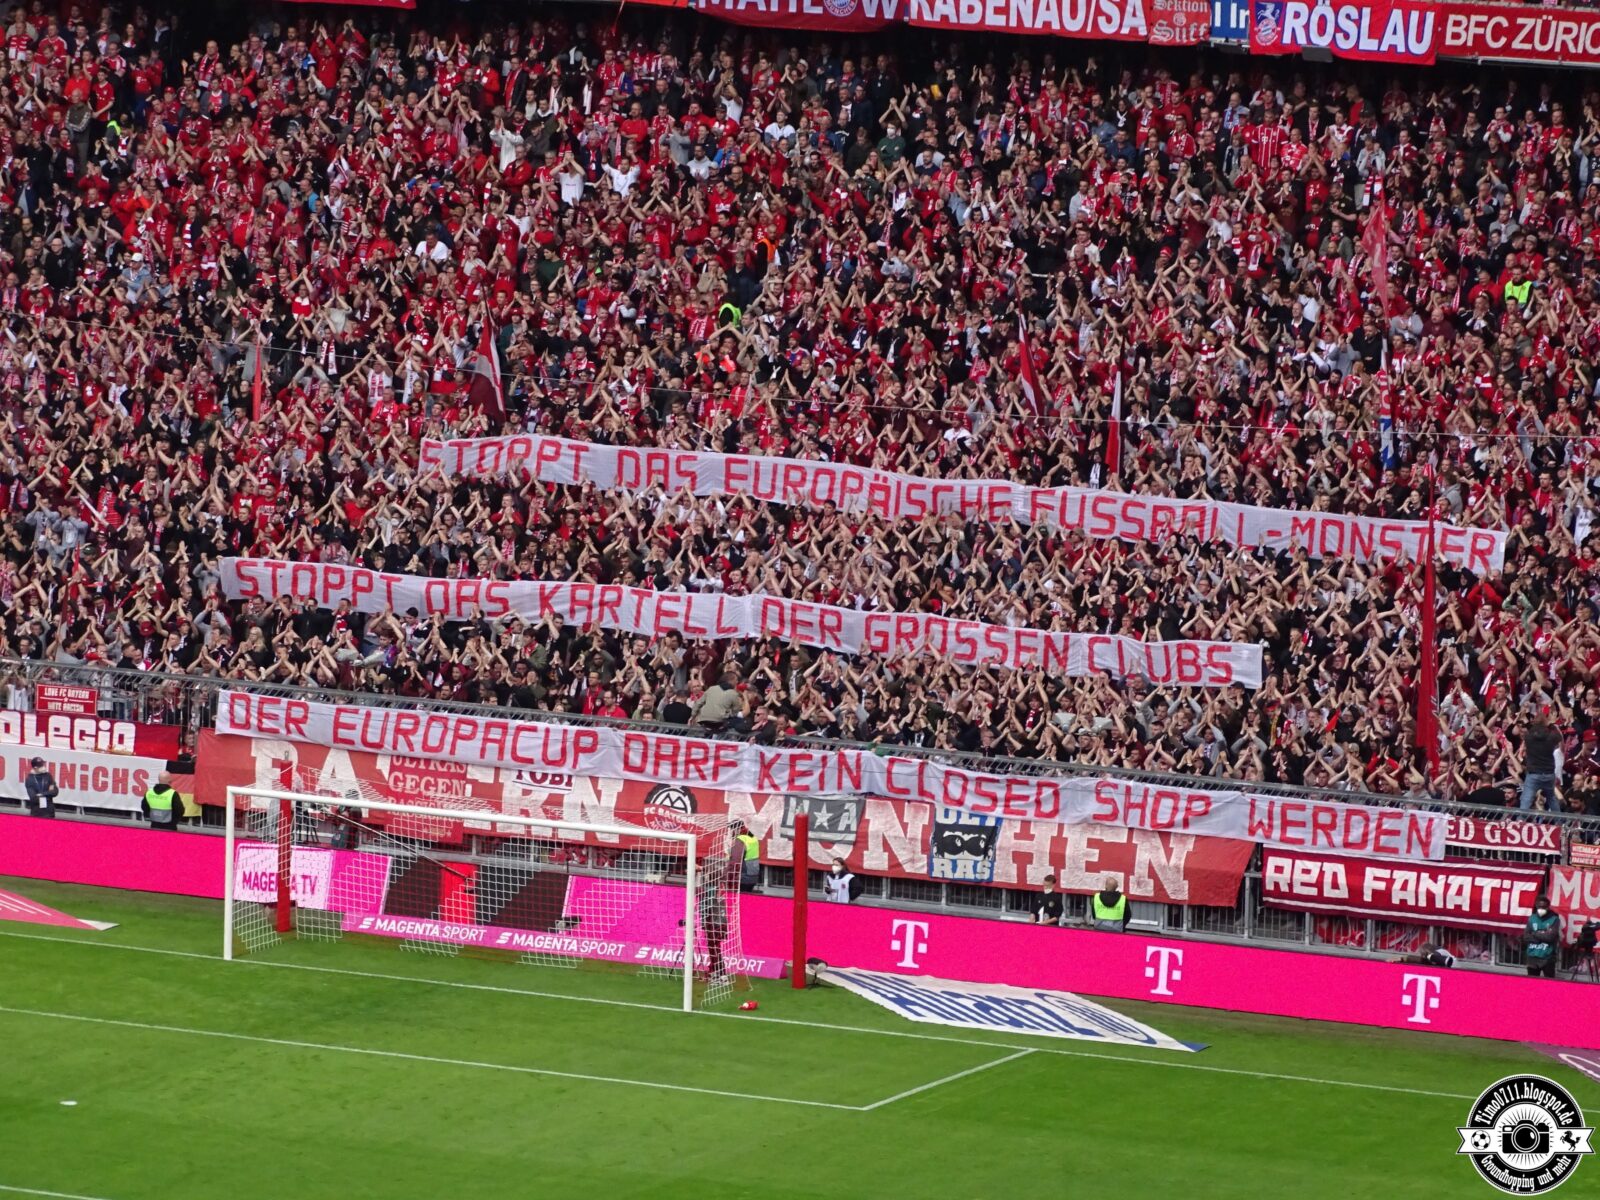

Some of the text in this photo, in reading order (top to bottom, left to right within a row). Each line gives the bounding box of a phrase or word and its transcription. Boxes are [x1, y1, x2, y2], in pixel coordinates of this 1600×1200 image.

[1282, 0, 1436, 56] RÖSLAU
[1445, 14, 1508, 49] BFC
[421, 436, 590, 482] STOPPT
[616, 449, 699, 493] DAS
[723, 456, 1013, 525] EUROPÄISCHE
[235, 560, 1233, 685] STOPPT DAS KARTELL DER GROSSEN CLUBS
[228, 692, 1436, 861] DER EUROPACUP DARF KEIN CLOSED SHOP WERDEN
[388, 772, 467, 798] GEGEN
[932, 858, 993, 881] RAS
[242, 871, 318, 896] MAGEA TV
[374, 916, 488, 943] MAGENTA SPORT
[512, 933, 626, 957] MAGENTA SPORT
[650, 948, 712, 968] MAGNT
